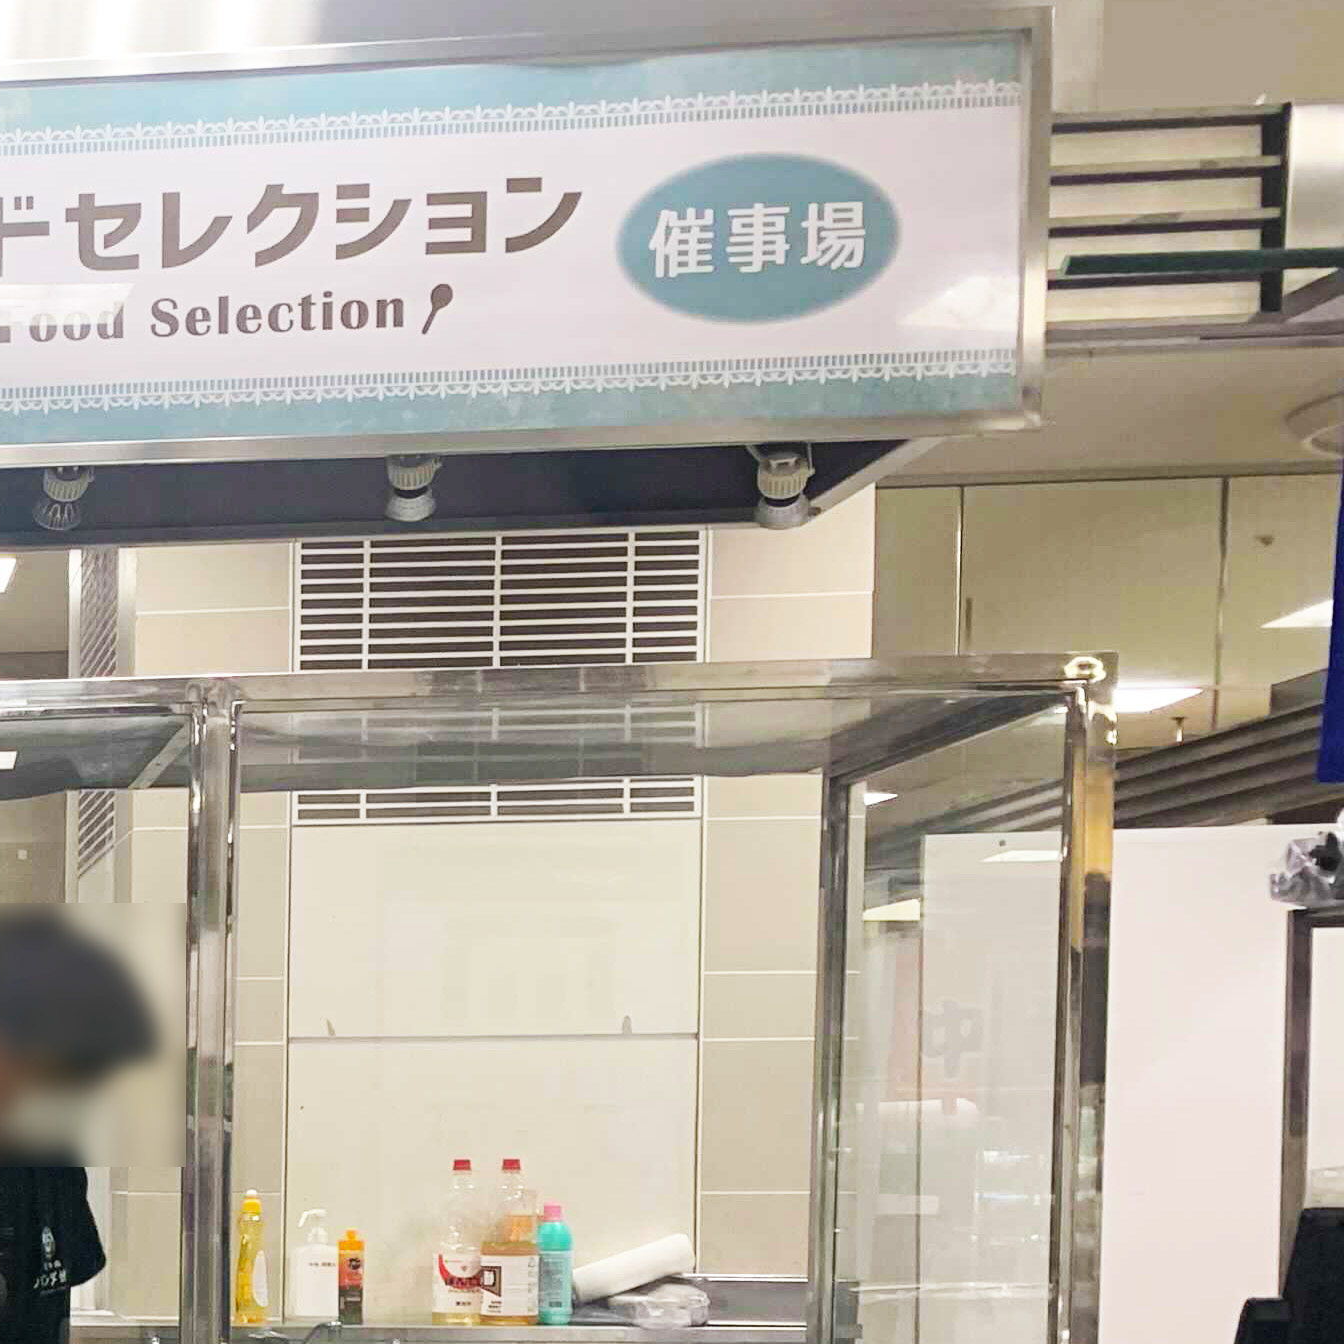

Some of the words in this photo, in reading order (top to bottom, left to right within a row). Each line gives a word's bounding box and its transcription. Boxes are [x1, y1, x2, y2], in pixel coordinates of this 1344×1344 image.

[648, 201, 868, 280] 催事場
[149, 289, 408, 342] Selection
